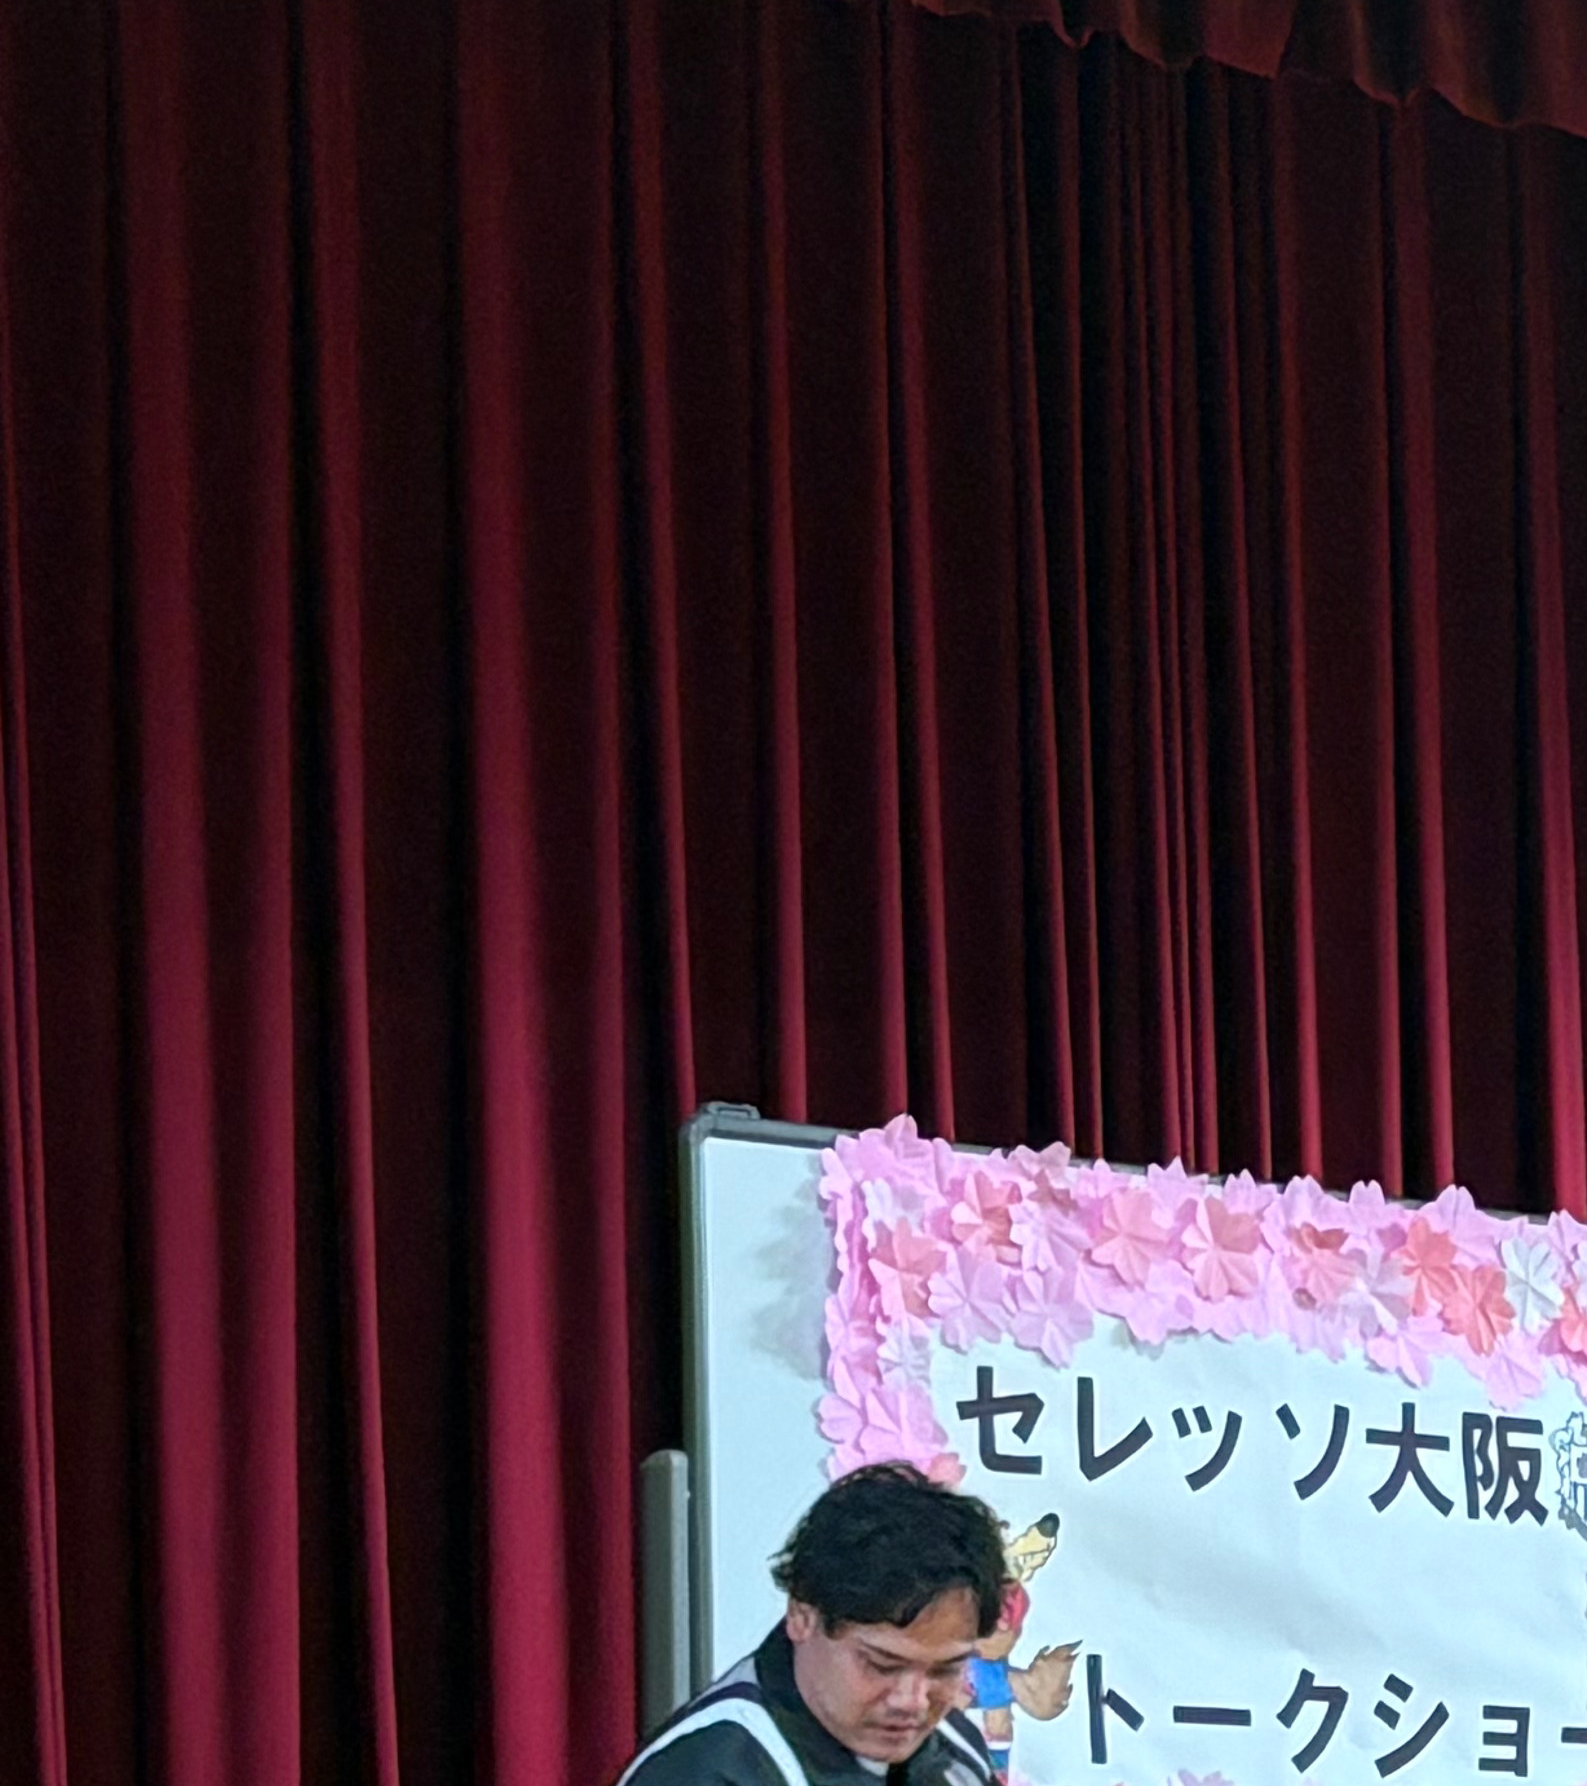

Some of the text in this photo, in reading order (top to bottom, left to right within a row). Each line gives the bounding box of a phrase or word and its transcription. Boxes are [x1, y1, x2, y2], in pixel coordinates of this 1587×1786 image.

[957, 1365, 1549, 1526] セレッソ大阪
